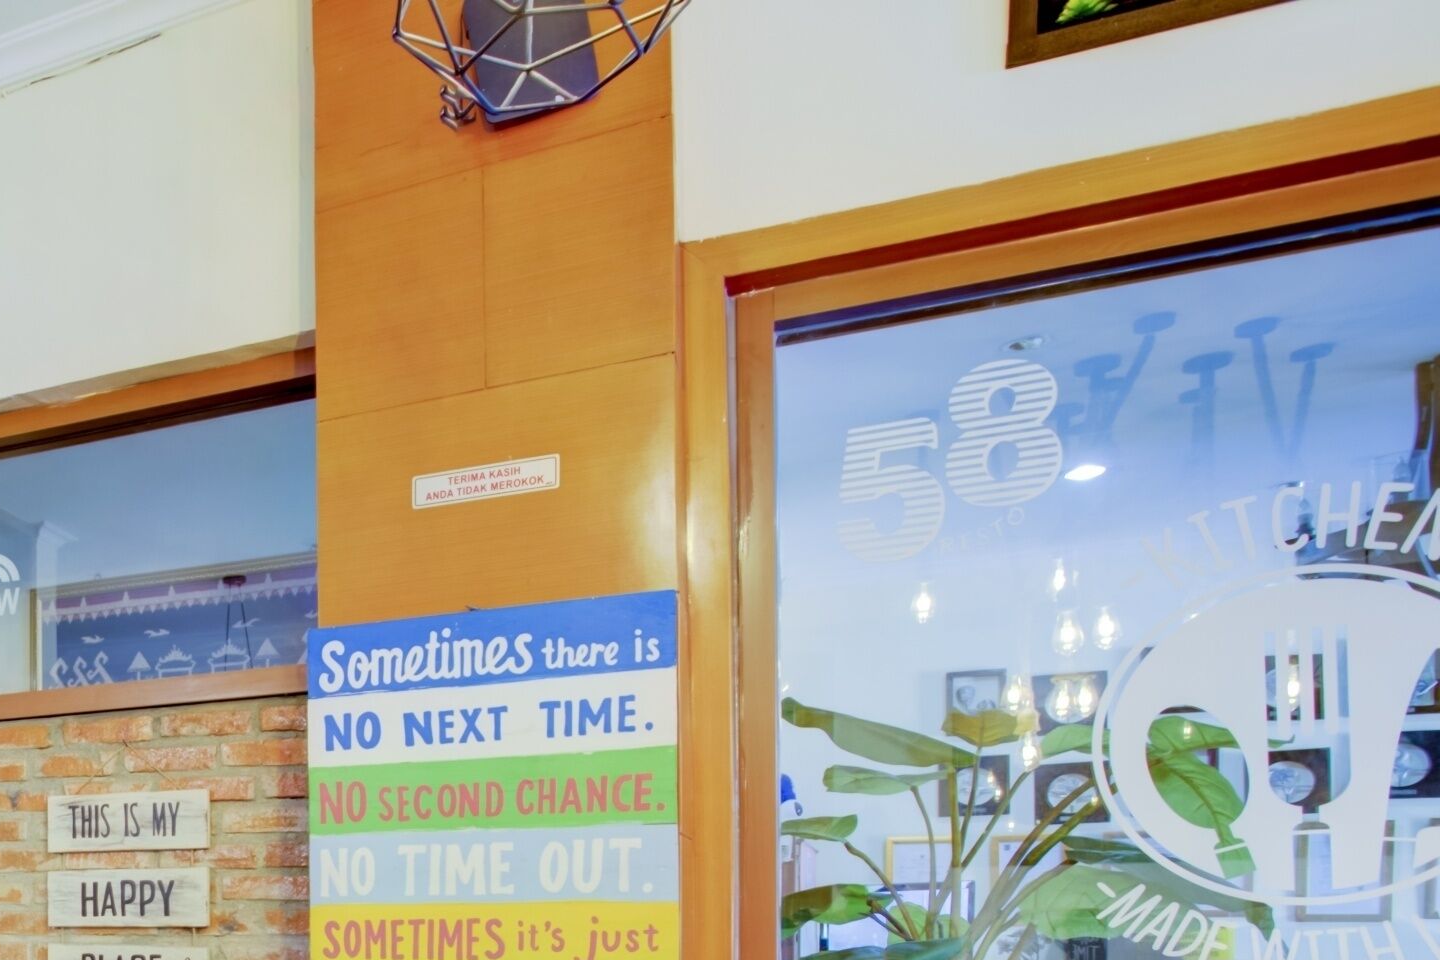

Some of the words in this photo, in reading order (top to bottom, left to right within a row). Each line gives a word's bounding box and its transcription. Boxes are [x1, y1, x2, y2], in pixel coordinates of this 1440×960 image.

[447, 472, 486, 487] TERIMA
[489, 466, 521, 480] KASIH
[837, 359, 1063, 562] 58
[425, 489, 454, 502] ANDA
[457, 484, 488, 497] TIDAK
[490, 475, 545, 491] MEROKOK
[318, 628, 534, 694] Sometimes
[541, 637, 619, 671] there
[633, 629, 660, 663] is
[323, 711, 382, 751] NO
[402, 705, 509, 749] NEXT
[539, 694, 654, 739] TIME.
[68, 803, 110, 839] THIS
[124, 802, 141, 837] IS
[152, 801, 180, 837] MY
[319, 781, 367, 825] NO
[377, 781, 504, 822] SECOND
[515, 773, 666, 816] CHANCE.
[319, 847, 376, 897] NO
[398, 841, 514, 897] TIME
[538, 838, 654, 894] OUT.
[80, 879, 175, 918] HAPPY
[322, 917, 505, 960] SOMETIMES
[517, 919, 566, 953] it's
